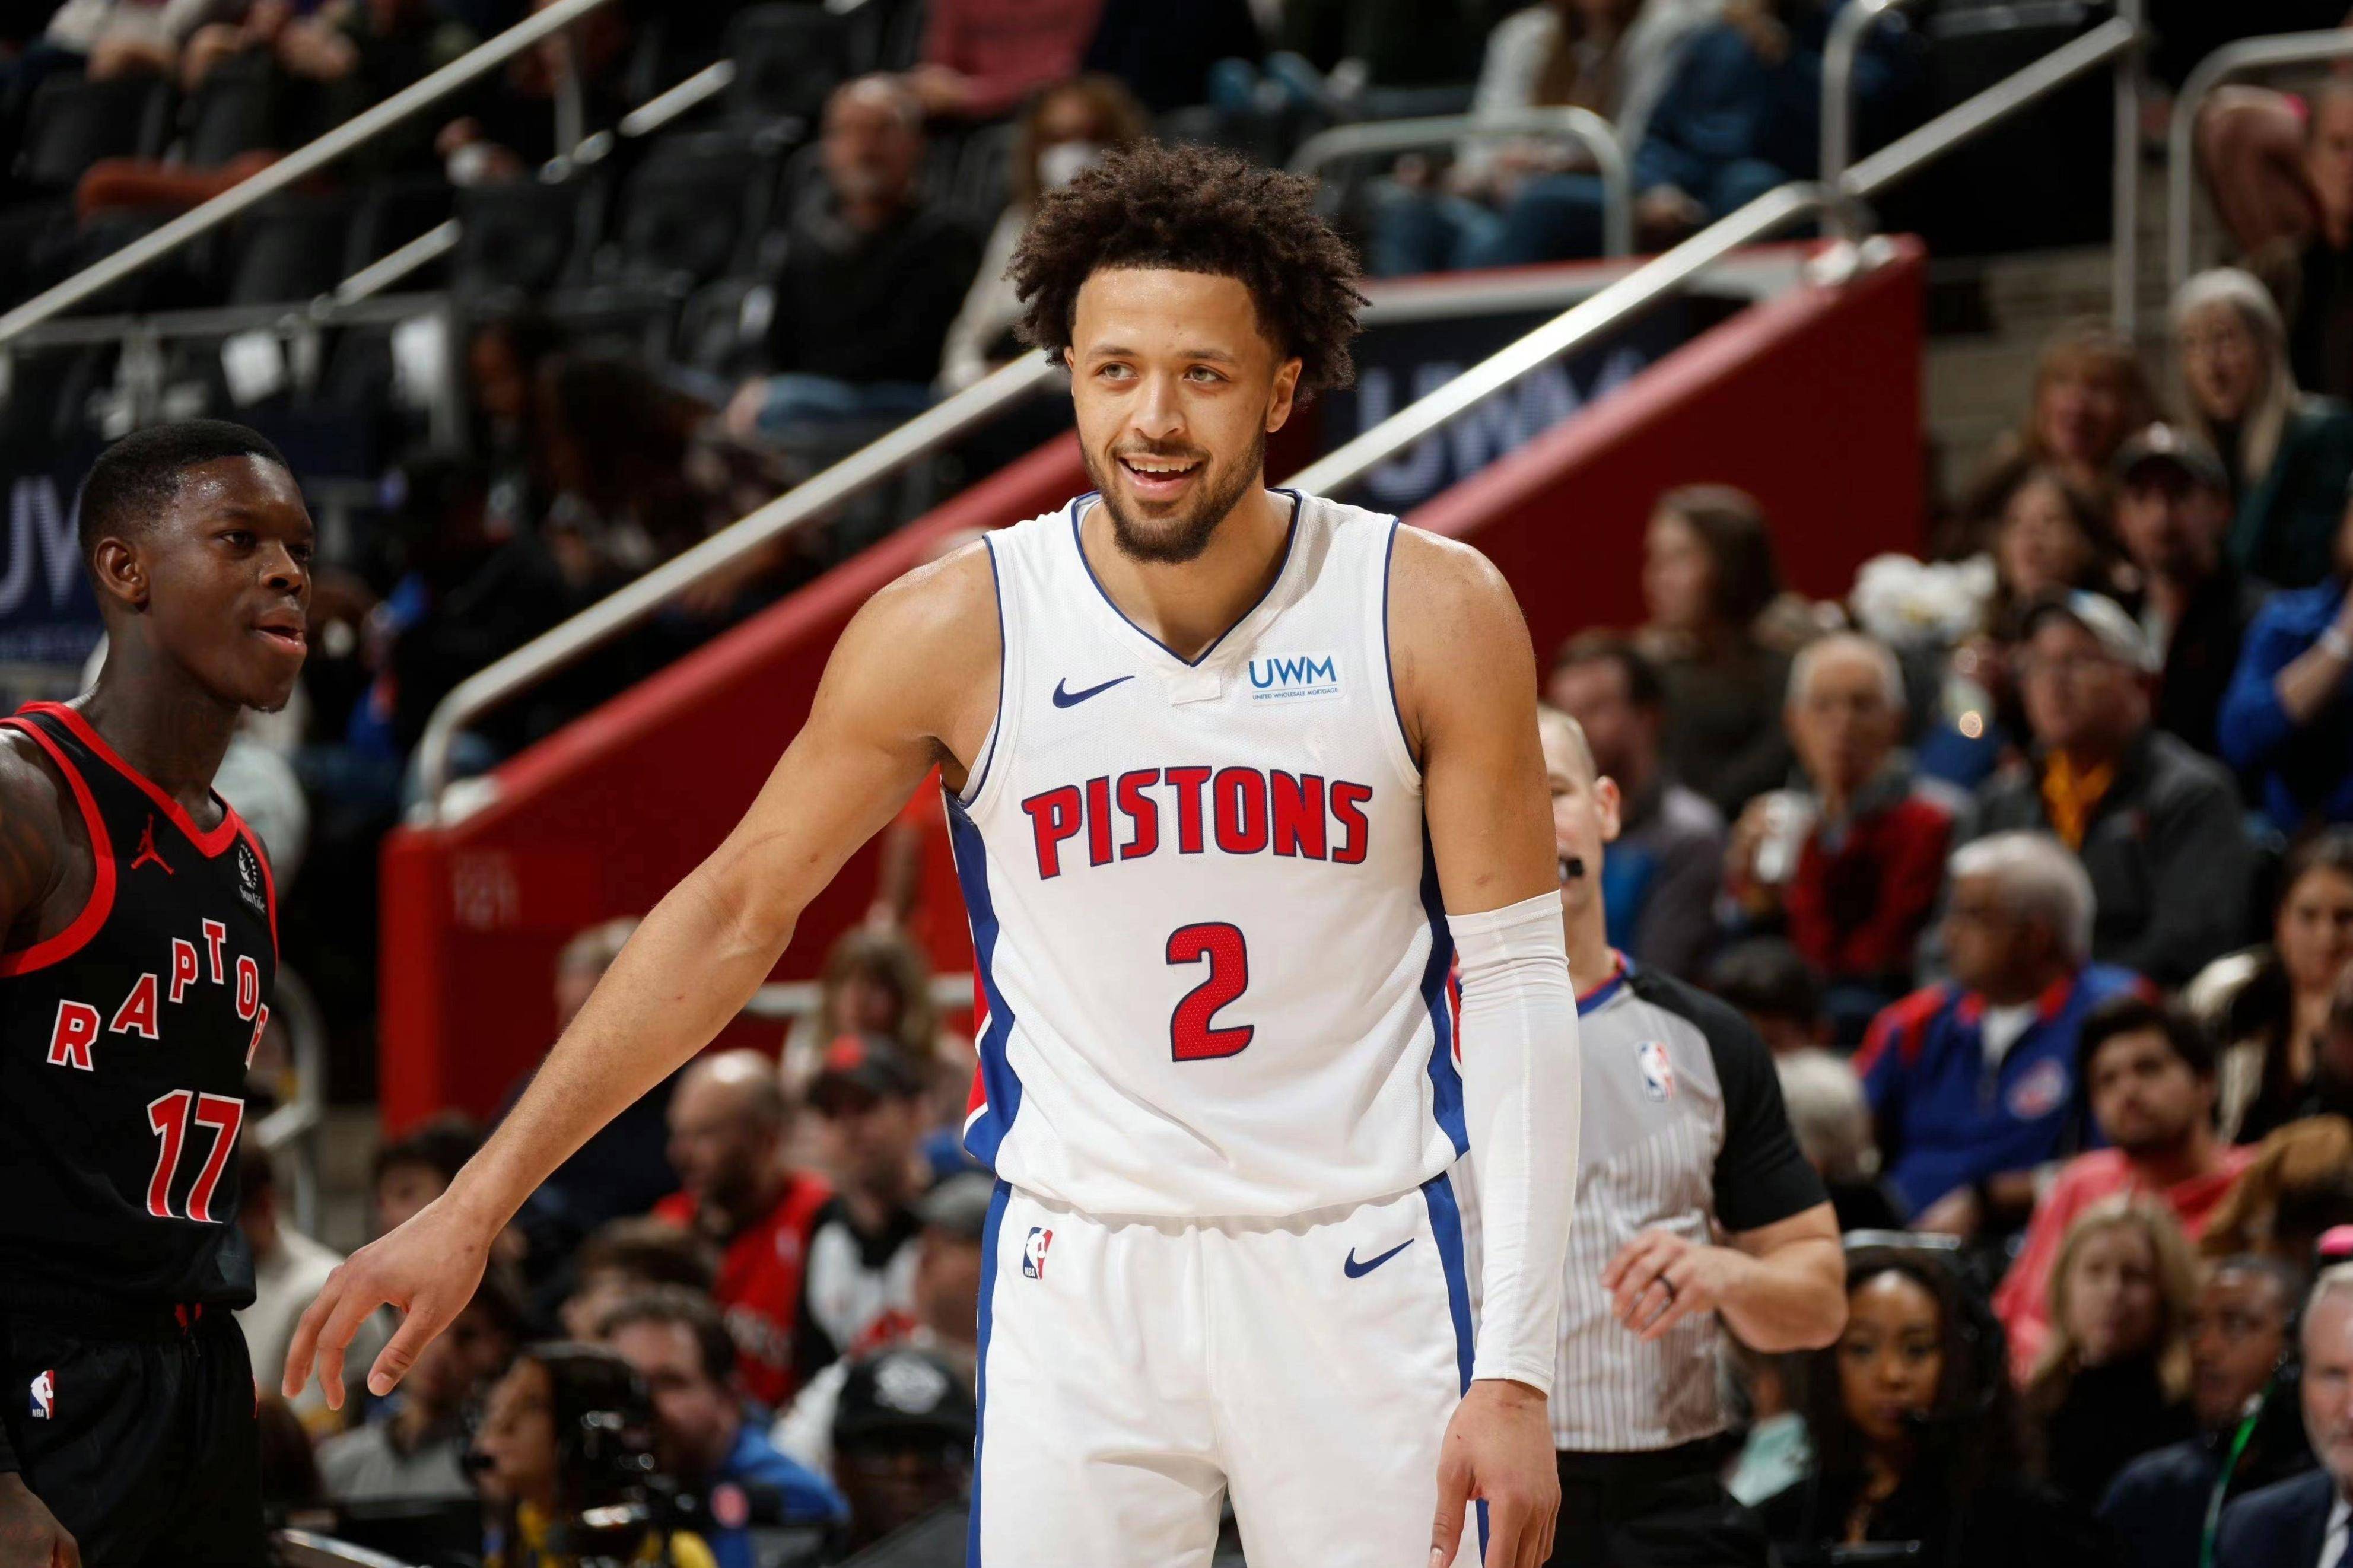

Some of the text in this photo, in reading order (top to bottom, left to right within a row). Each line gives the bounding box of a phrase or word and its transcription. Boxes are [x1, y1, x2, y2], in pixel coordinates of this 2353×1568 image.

[1249, 655, 1336, 688] UWM
[1021, 765, 1373, 880] PISTONS
[1165, 921, 1255, 1063] 2
[147, 1089, 245, 1223] 17
[1025, 1267, 1036, 1277] NBA
[32, 1408, 44, 1418] NBA
